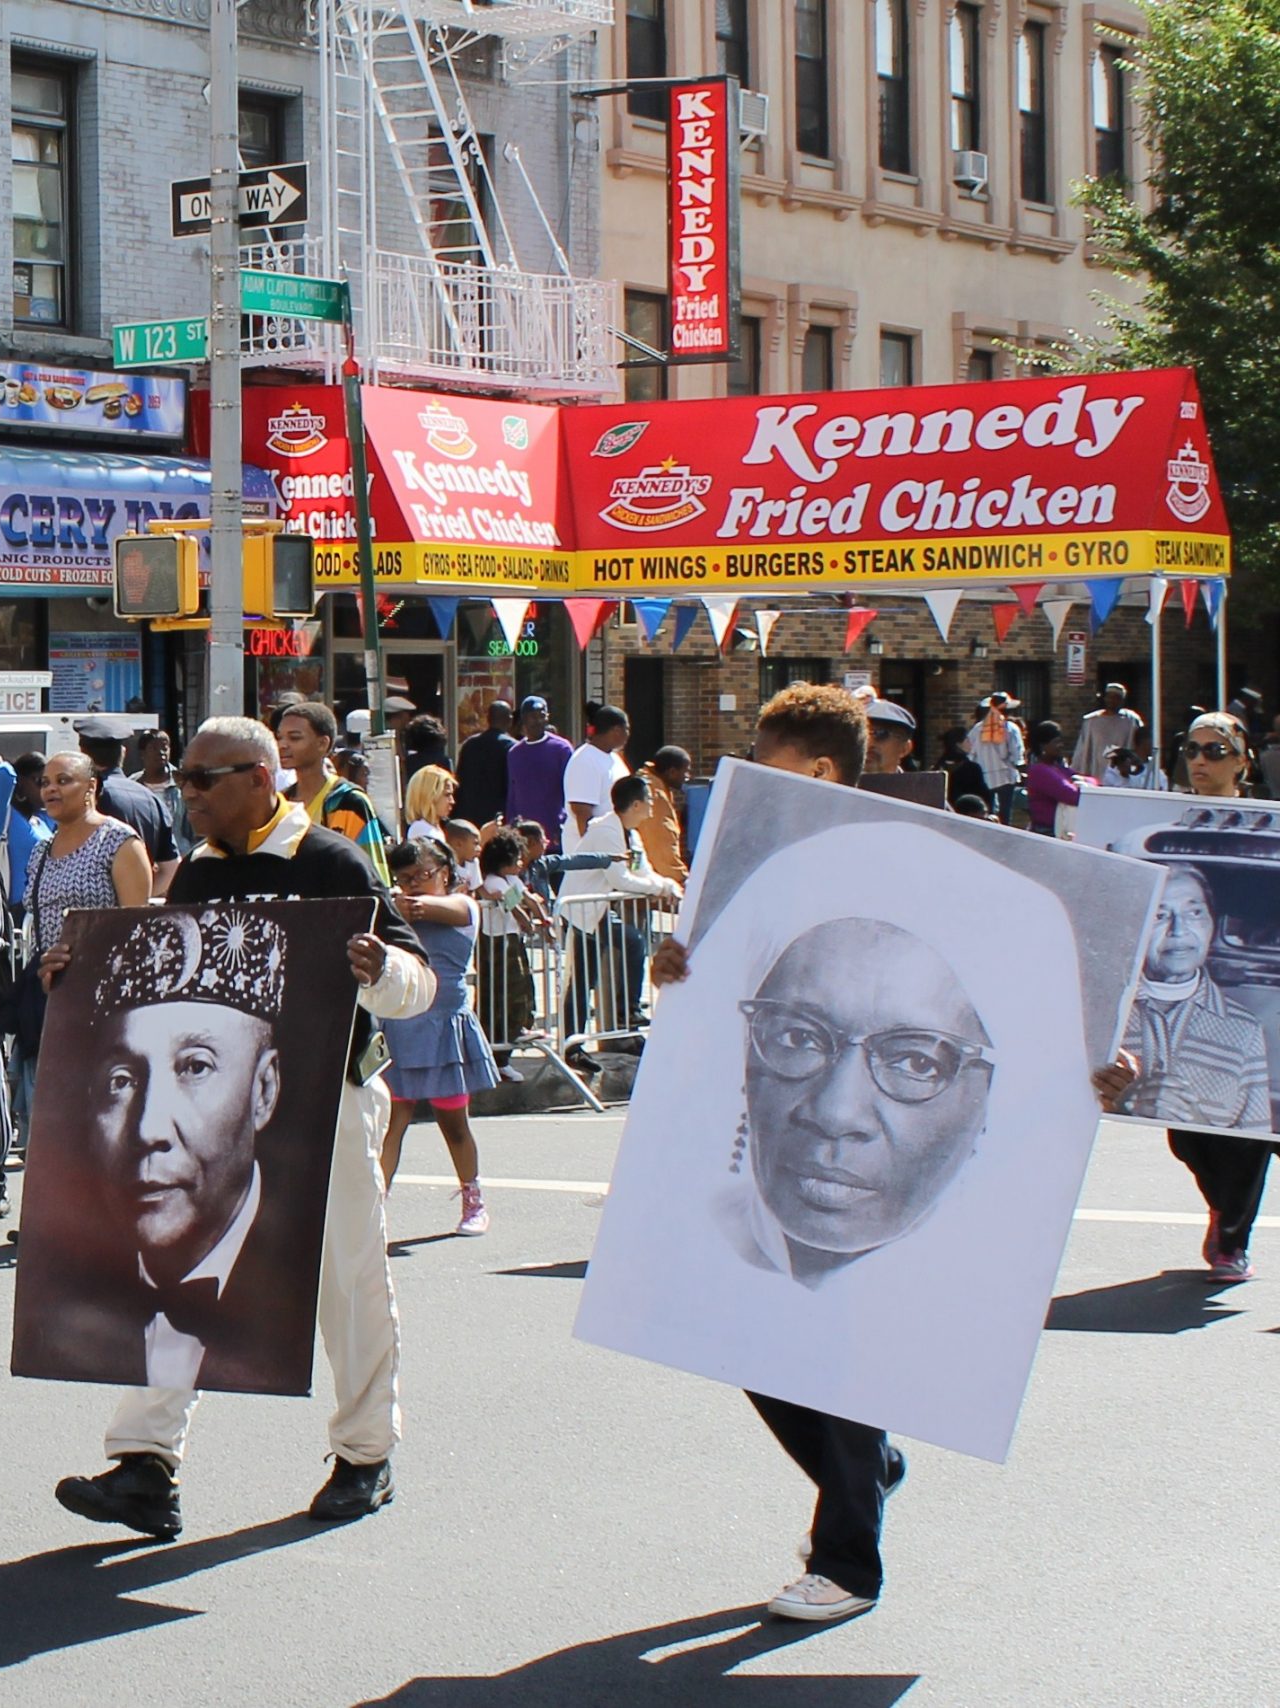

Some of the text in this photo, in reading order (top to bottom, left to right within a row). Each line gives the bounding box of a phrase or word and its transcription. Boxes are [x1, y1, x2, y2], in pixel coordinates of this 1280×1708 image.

[190, 185, 286, 217] ON WAY
[677, 91, 716, 293] KENNEDY
[676, 294, 718, 321] Fried
[119, 323, 203, 361] W 123 ST
[672, 323, 722, 350] Chicken
[270, 419, 324, 431] KENNEDY'S
[742, 384, 1145, 484] Kennedy
[392, 450, 532, 507] Kennedy
[613, 479, 709, 495] KENNEDY'S
[716, 482, 871, 539] Fried
[880, 474, 1117, 535] Chicken
[308, 510, 377, 539] Chickn
[410, 503, 562, 547] Fried Chicken
[33, 555, 111, 567] PRODUCTS
[315, 550, 402, 577] OOD SADS
[423, 552, 569, 583] GYROS SEA FOOD SALADS DRINKS
[594, 540, 1129, 581] HOT WINGS BURGERS STEAK SANDWICH GYRO
[1155, 540, 1225, 568] STEAK SANDWICH
[25, 569, 52, 582] CUTS
[60, 569, 99, 584] FROZEN
[101, 571, 114, 583] FO
[250, 628, 312, 656] CHICKEN
[488, 640, 538, 657] SEAOOD
[6, 691, 36, 710] ICE
